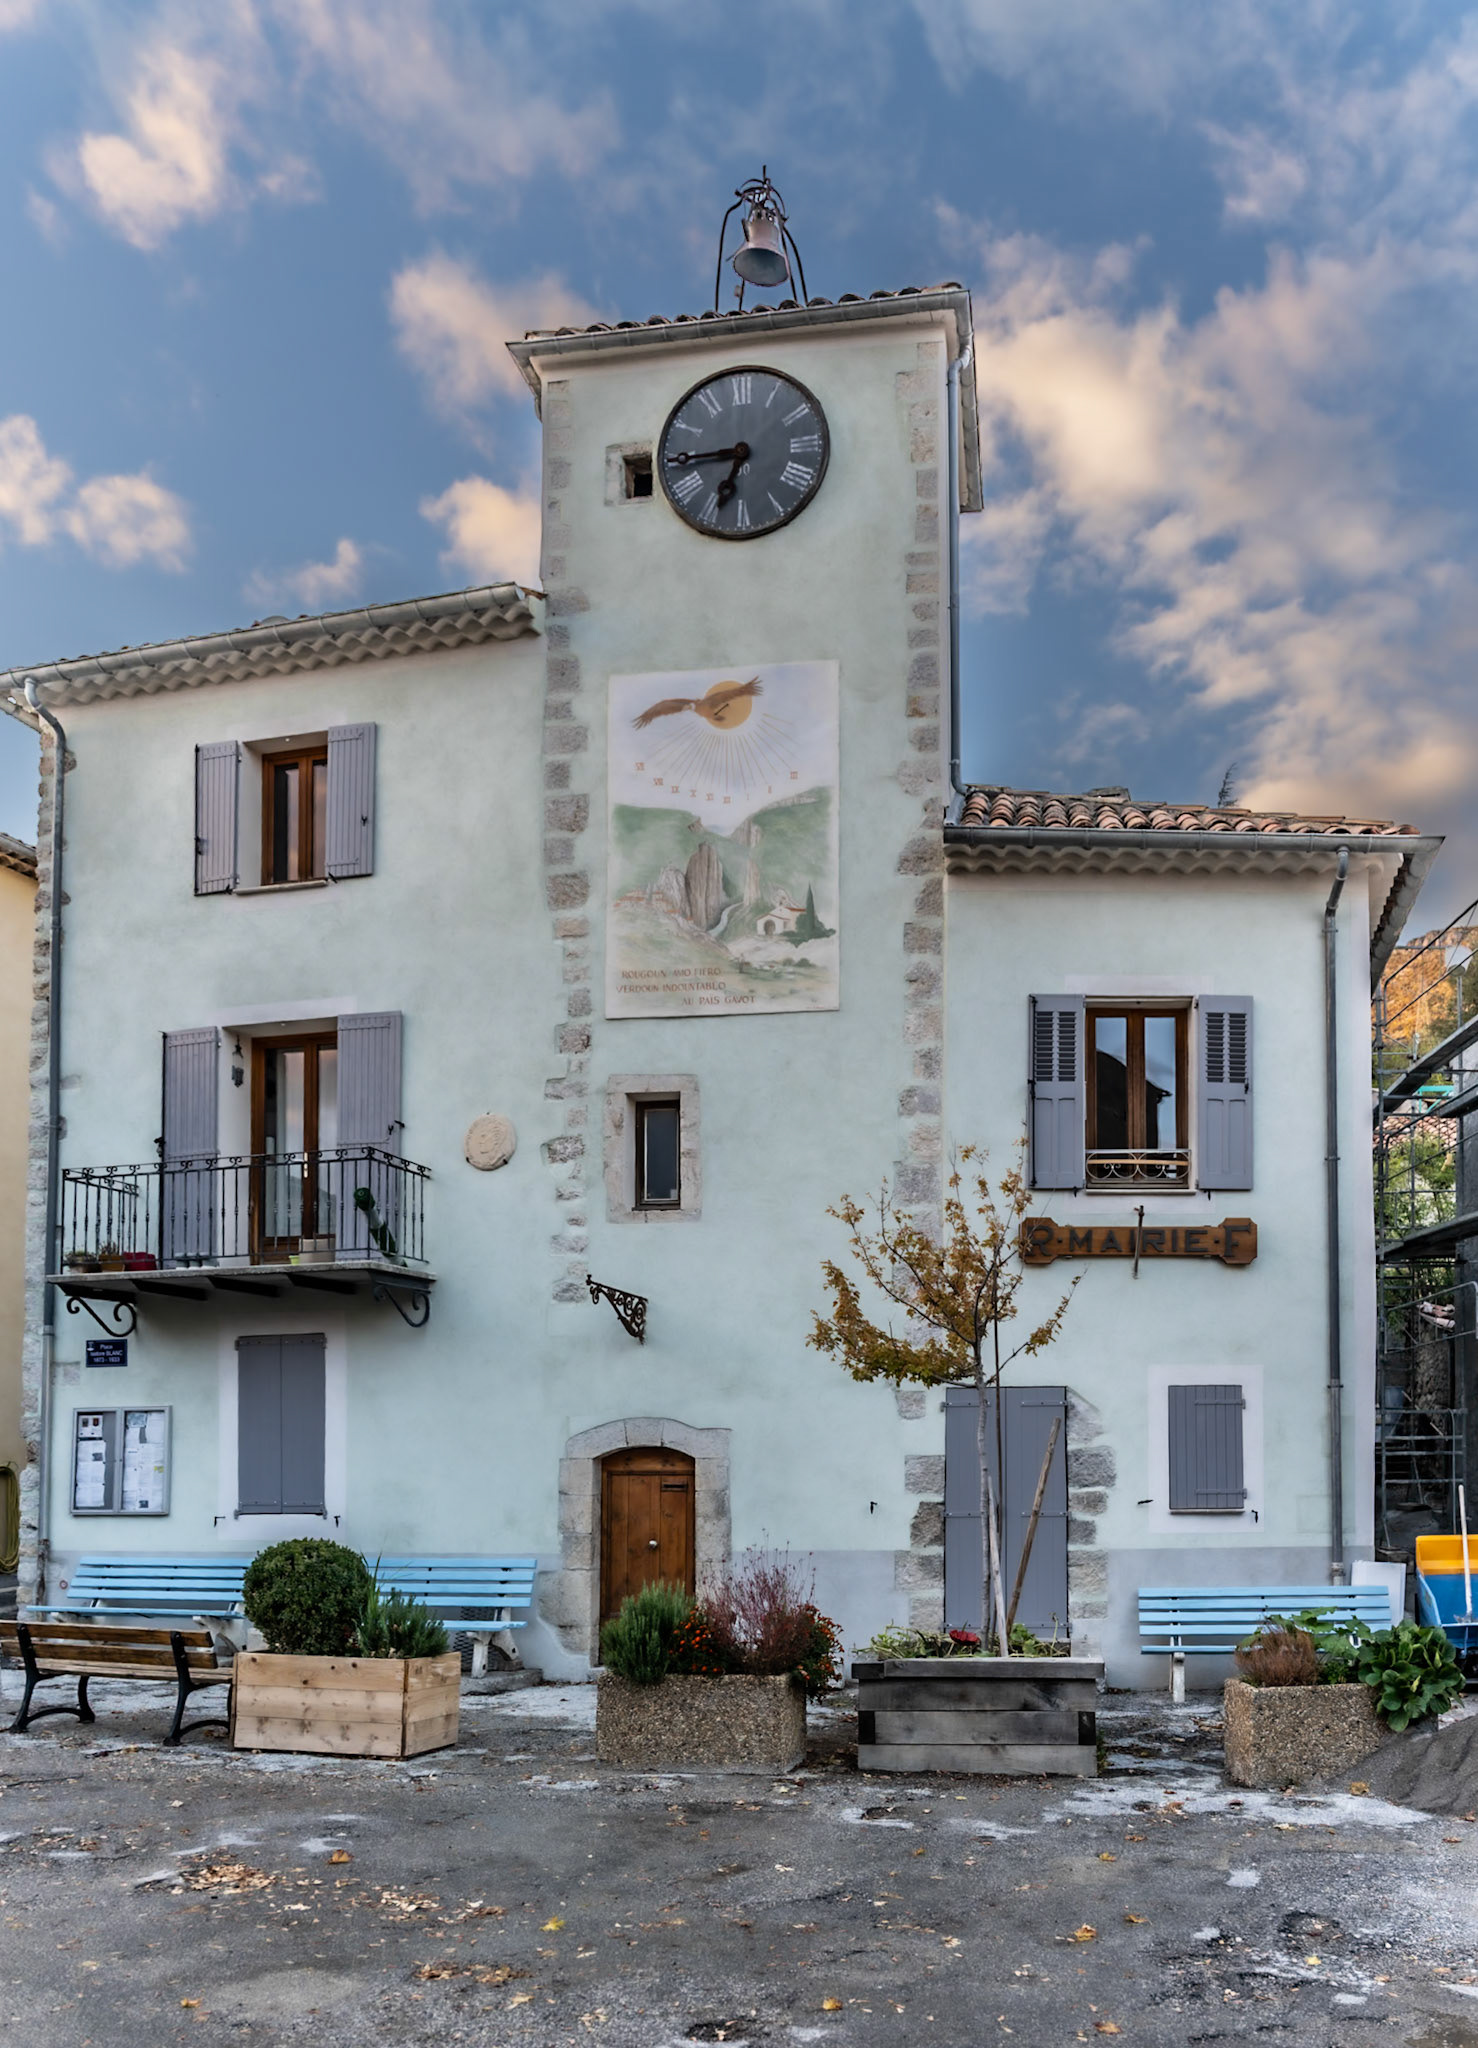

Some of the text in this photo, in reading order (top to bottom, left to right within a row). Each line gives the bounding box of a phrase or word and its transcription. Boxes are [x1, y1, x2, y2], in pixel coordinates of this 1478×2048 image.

[732, 376, 752, 406] XII
[698, 388, 723, 419] XI
[782, 402, 811, 427] II
[674, 419, 704, 438] X
[790, 434, 819, 453] III
[621, 968, 667, 979] ROUGOUN
[681, 997, 694, 1006] AU
[724, 994, 756, 1004] GAVOT
[1069, 1229, 1208, 1253] MAIRIE
